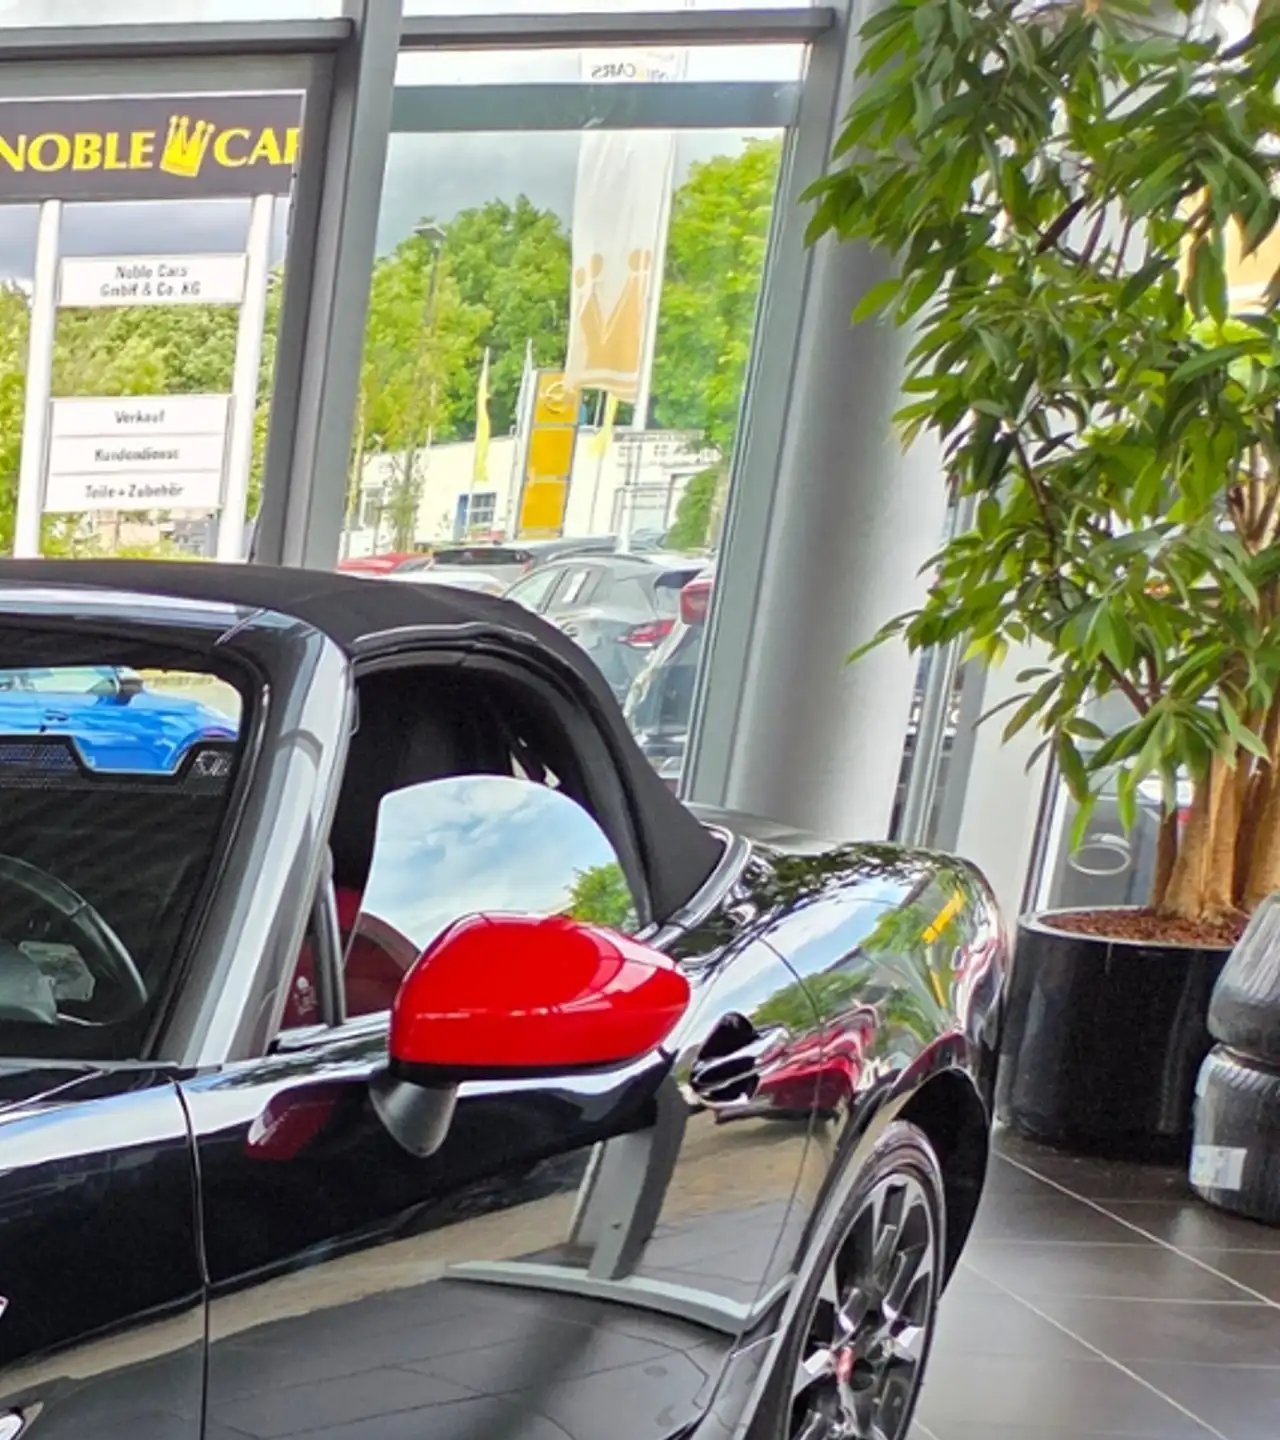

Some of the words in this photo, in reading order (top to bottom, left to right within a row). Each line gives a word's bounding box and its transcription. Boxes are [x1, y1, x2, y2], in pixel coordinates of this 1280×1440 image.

[115, 264, 153, 279] Noble
[157, 264, 189, 278] Cars
[100, 282, 138, 297] GmbH
[114, 409, 165, 424] Verkauf
[94, 448, 180, 462] Kundendienst
[85, 484, 115, 499] Teile
[128, 481, 184, 498] Zubehör
